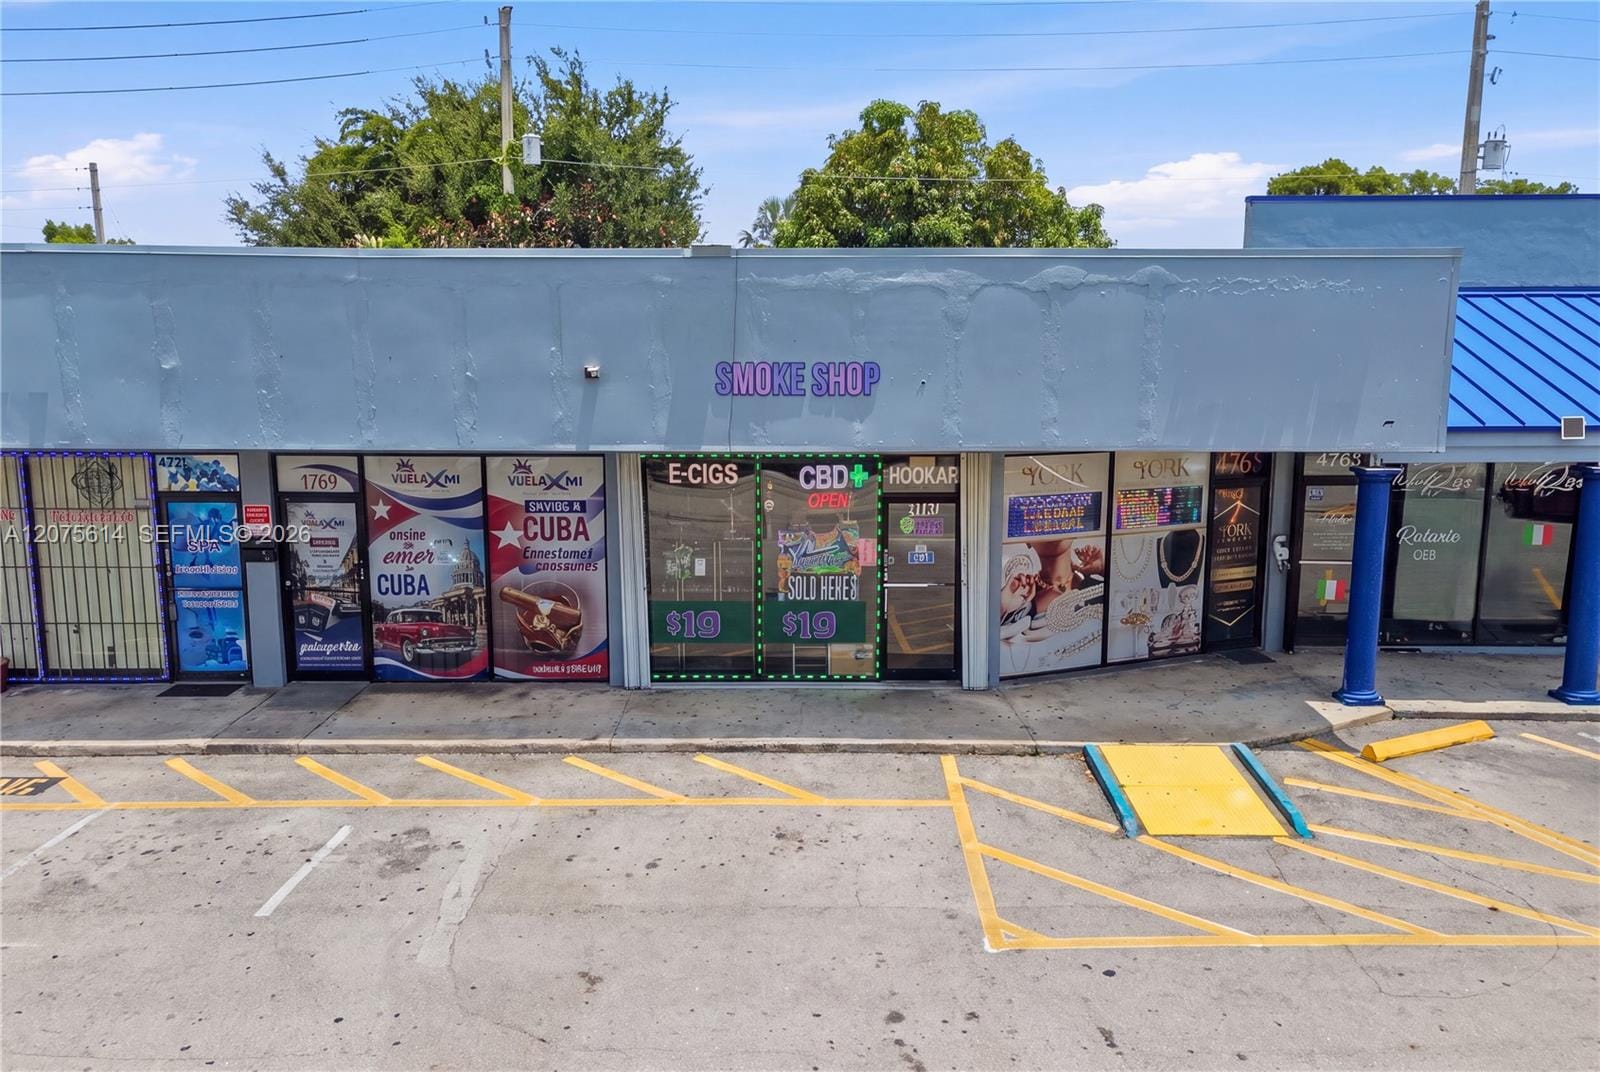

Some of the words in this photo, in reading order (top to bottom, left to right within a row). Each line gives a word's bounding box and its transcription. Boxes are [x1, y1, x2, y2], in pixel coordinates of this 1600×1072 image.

[715, 361, 806, 397] SMOKE
[811, 361, 881, 397] SHOP
[668, 463, 739, 484] E-CIGS
[800, 464, 849, 490] CBD
[1133, 457, 1190, 480] YORK
[301, 474, 337, 490] 1769
[807, 492, 850, 509] OPEN
[523, 515, 590, 542] CUBA
[187, 540, 223, 553] SPA
[377, 574, 430, 596] CUBA
[788, 575, 816, 600] SOLD
[666, 610, 721, 638] $19
[782, 611, 837, 639] $19
